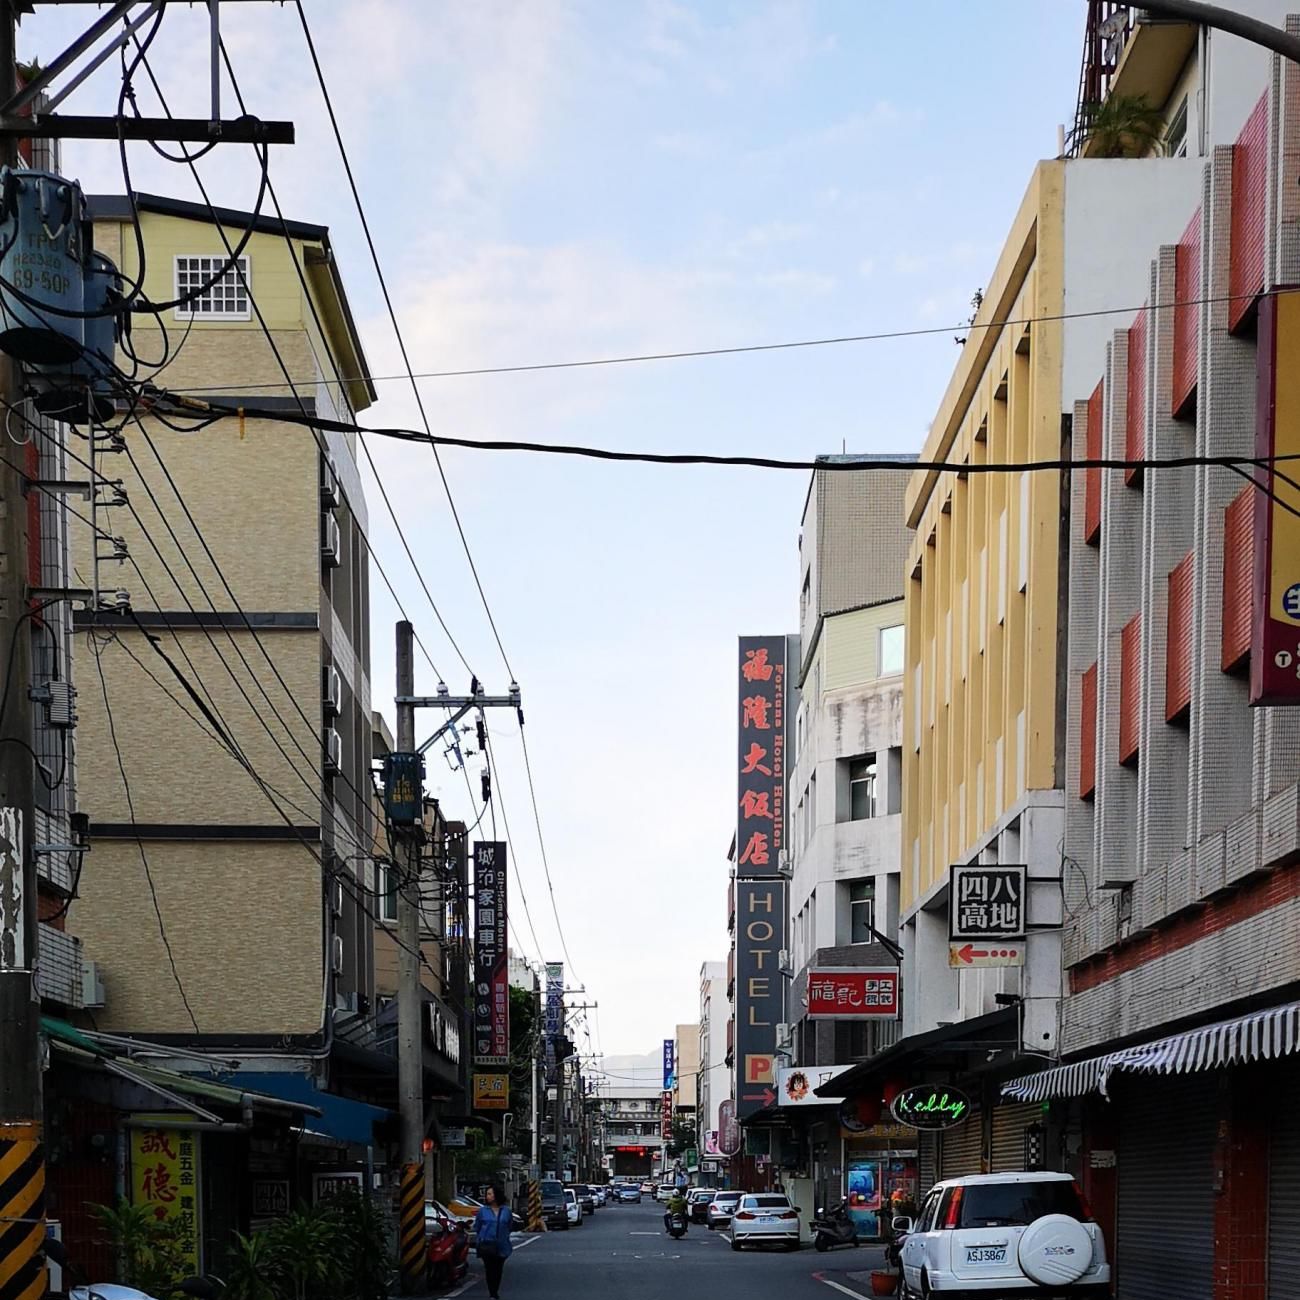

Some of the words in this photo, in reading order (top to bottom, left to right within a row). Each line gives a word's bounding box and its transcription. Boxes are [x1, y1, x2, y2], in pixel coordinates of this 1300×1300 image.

[738, 648, 774, 865] 福隆大飯店
[774, 735, 783, 778] Hotel
[961, 876, 1018, 901] 四八
[478, 847, 496, 967] 城市家園車行
[960, 903, 1017, 928] 高地
[747, 893, 774, 1026] HOTEL
[811, 980, 862, 1006] 福記
[866, 980, 893, 992] 手工
[751, 1058, 770, 1081] P
[479, 1078, 504, 1091] 民宿
[900, 1093, 966, 1118] Kelly
[140, 1131, 178, 1202] 誠德
